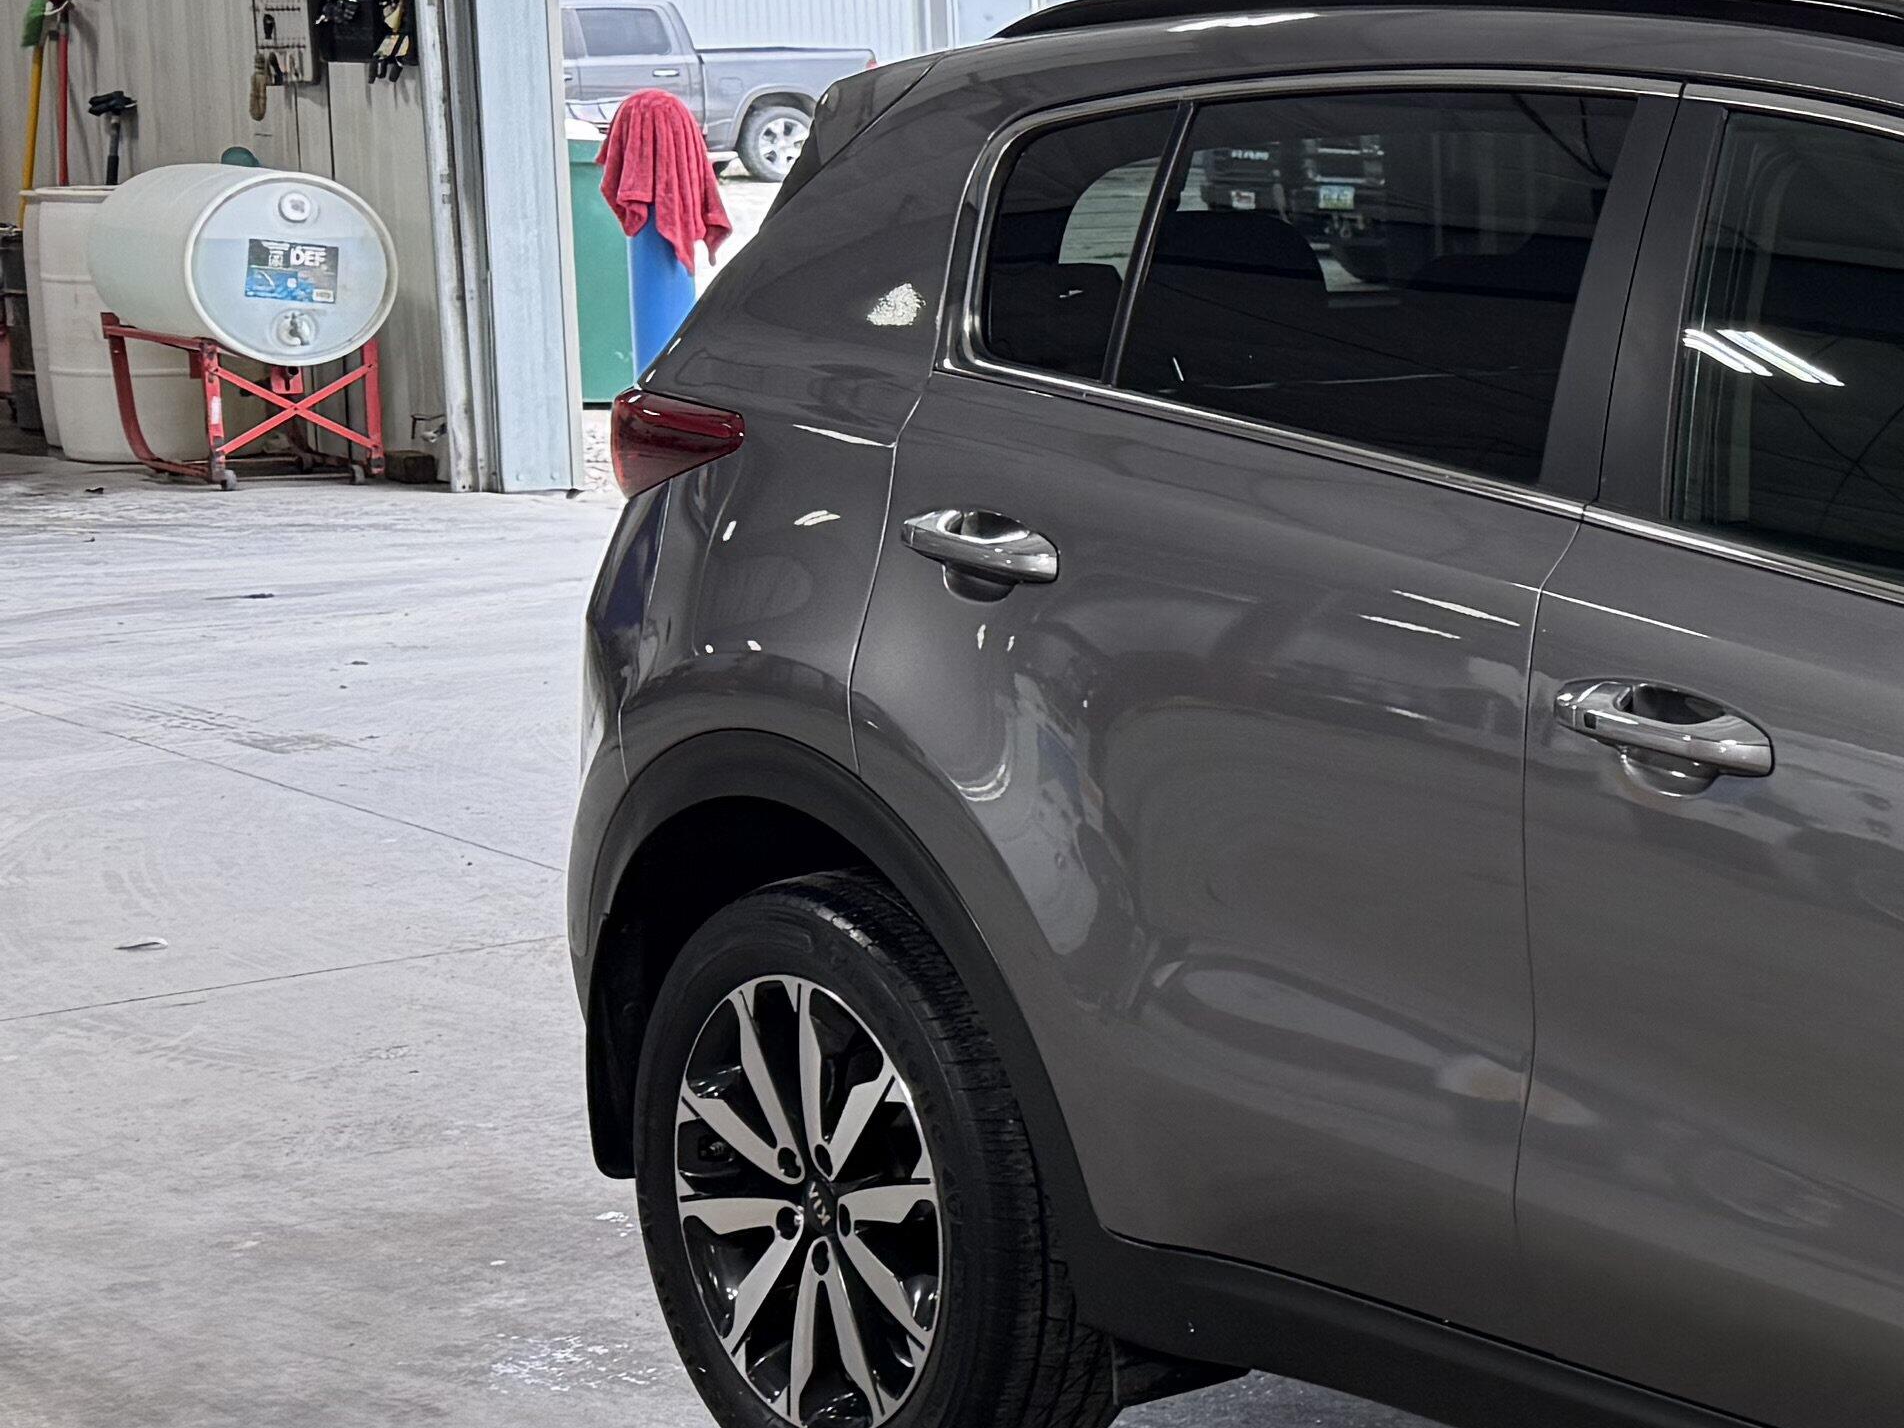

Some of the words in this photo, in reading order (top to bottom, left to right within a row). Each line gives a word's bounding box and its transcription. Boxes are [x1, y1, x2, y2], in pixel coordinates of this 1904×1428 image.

[1231, 149, 1270, 161] RAM
[290, 246, 327, 267] DEF
[808, 1180, 831, 1228] KIA
